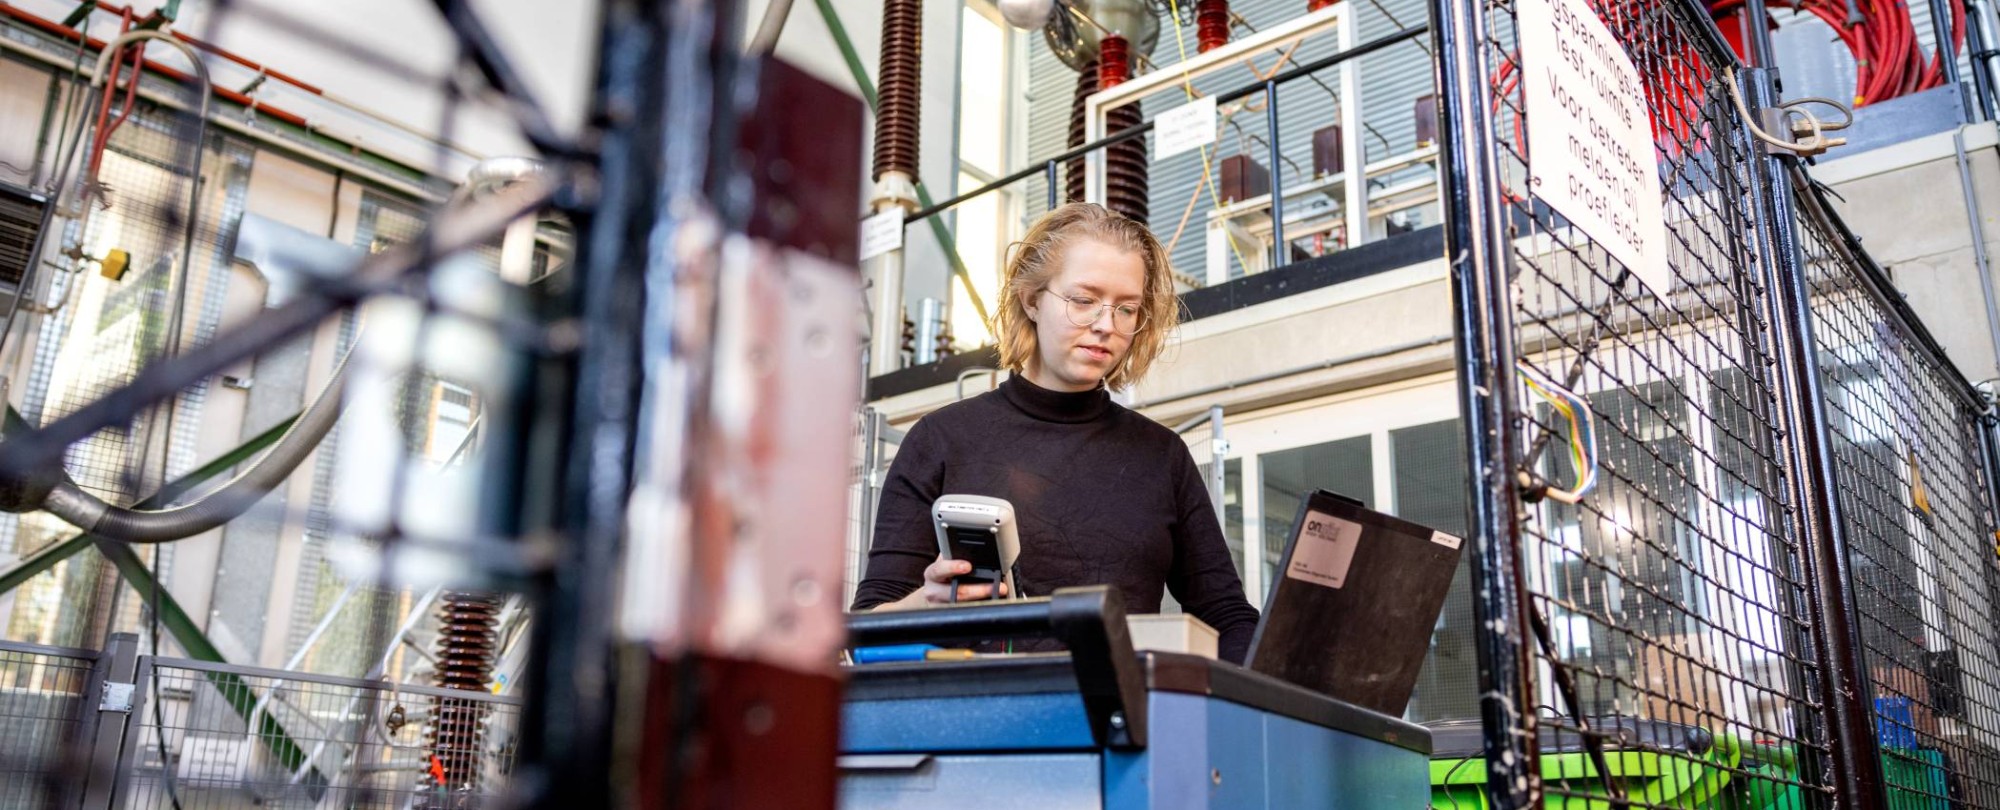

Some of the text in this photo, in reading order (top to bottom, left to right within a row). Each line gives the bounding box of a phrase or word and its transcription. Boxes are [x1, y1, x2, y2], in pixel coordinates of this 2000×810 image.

[1552, 21, 1632, 130] Test ruimte
[1547, 65, 1646, 191] Voor betreden
[1568, 132, 1639, 224] melden bij
[1568, 171, 1644, 256] proefleider
